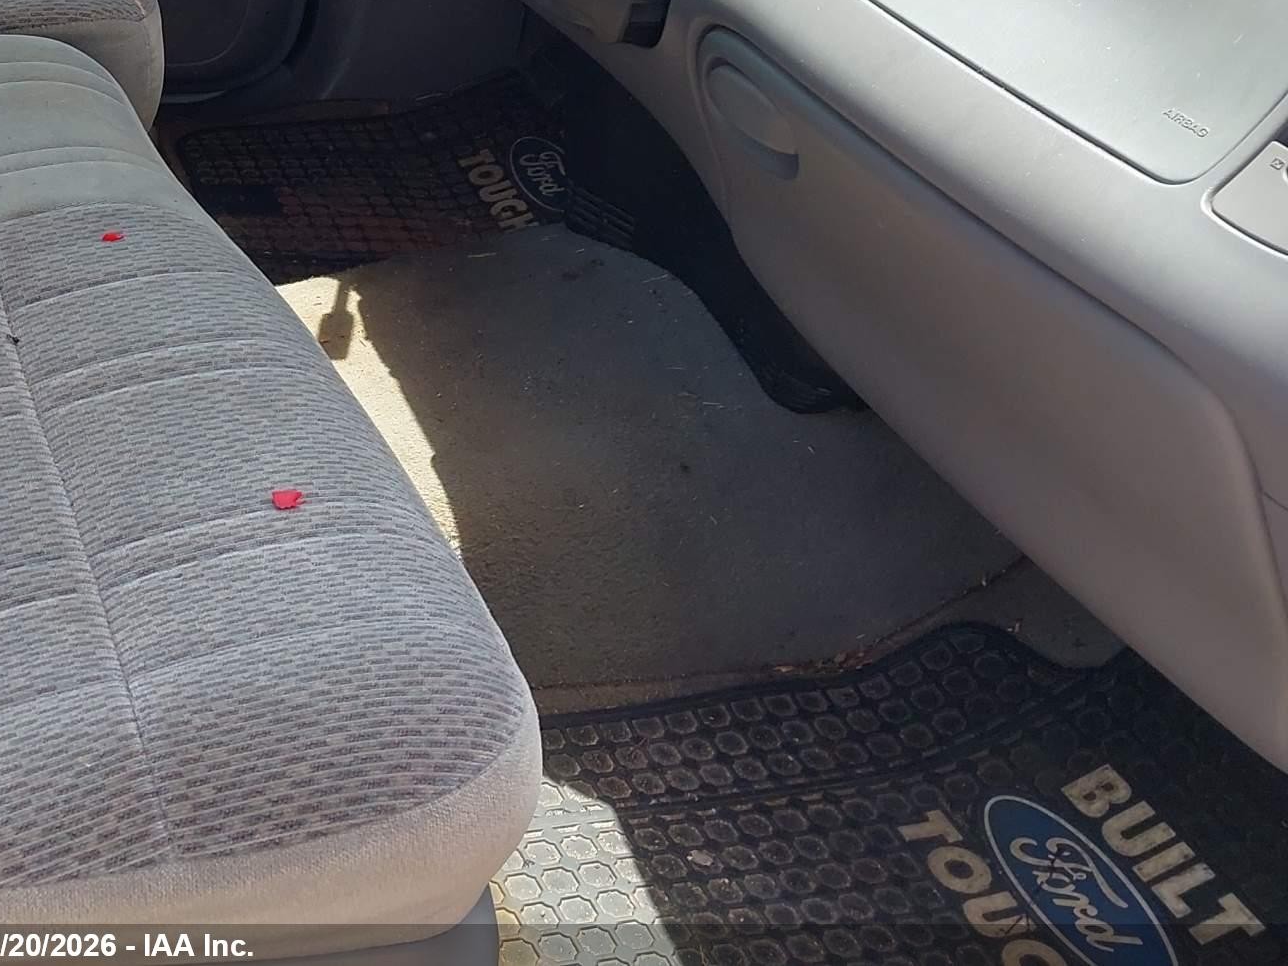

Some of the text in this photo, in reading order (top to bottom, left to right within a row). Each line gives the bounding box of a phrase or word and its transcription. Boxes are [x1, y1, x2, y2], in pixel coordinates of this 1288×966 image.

[519, 150, 567, 197] Ford
[1010, 836, 1144, 952] Ford
[1061, 764, 1266, 946] BUILT
